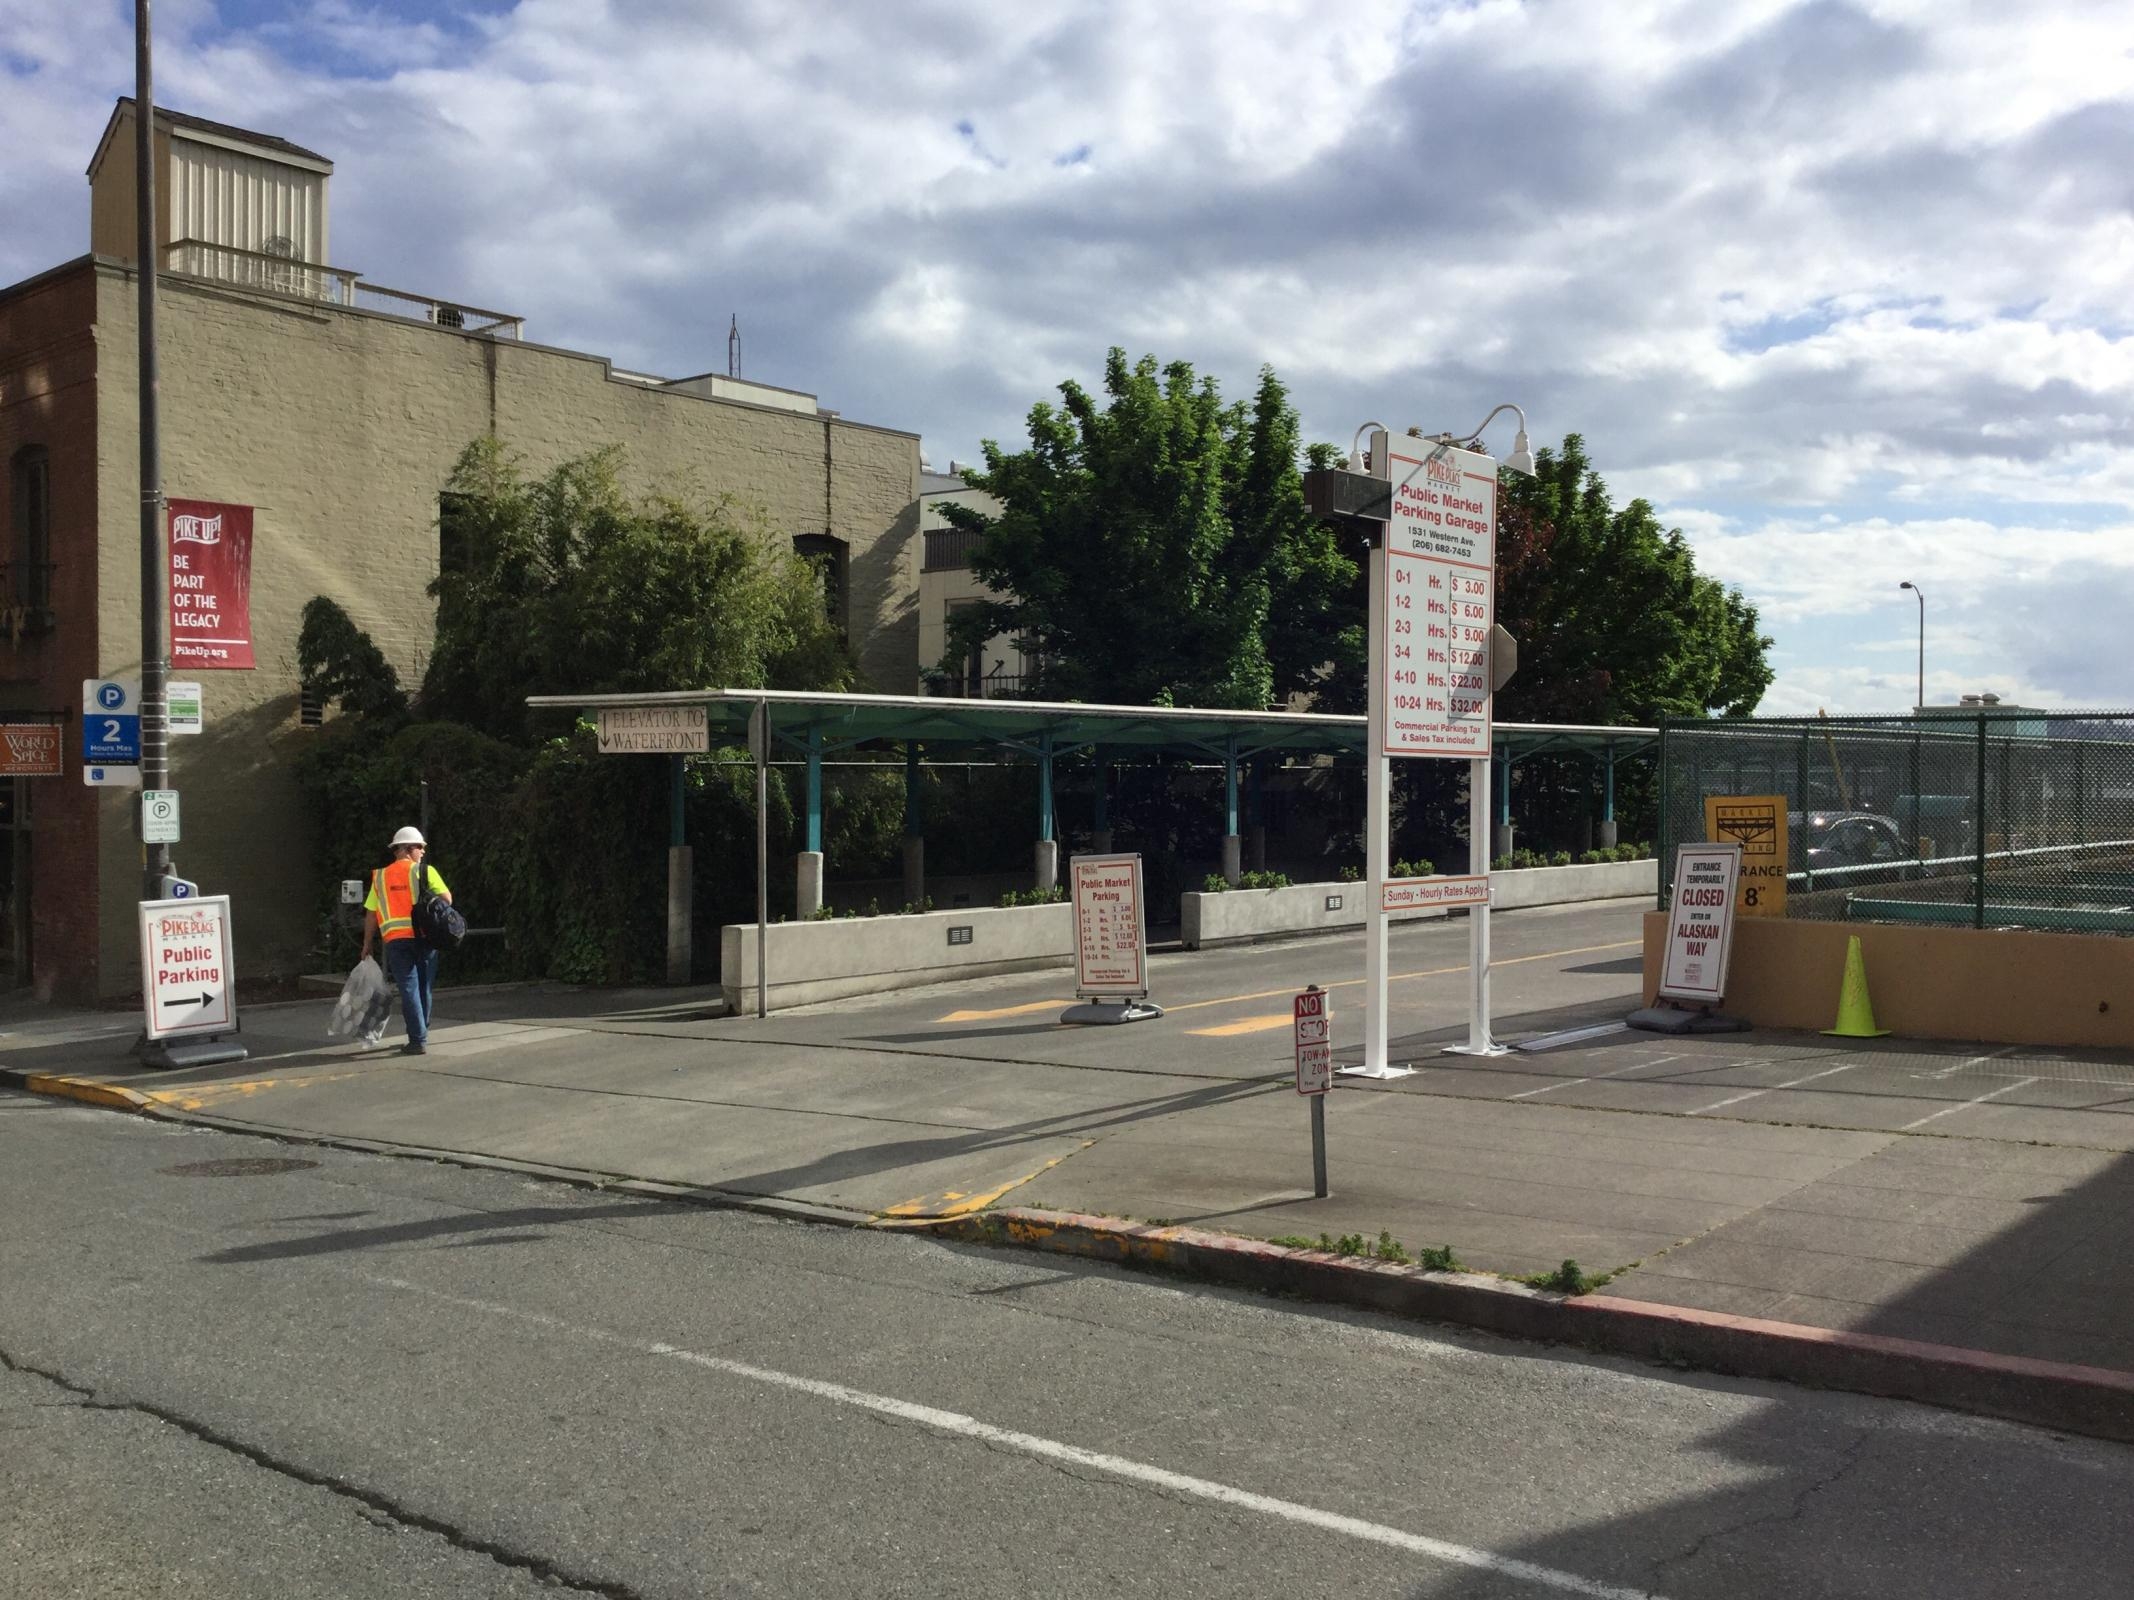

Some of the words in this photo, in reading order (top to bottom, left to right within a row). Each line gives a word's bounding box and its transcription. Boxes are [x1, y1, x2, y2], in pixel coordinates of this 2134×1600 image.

[1401, 484, 1438, 504] Public
[1442, 494, 1483, 514] Market
[1394, 501, 1441, 525] Parking
[1446, 513, 1488, 534] Garage
[174, 517, 199, 541] PIKE
[202, 515, 221, 541] UP!
[1408, 526, 1426, 537] 1531
[1429, 530, 1459, 542] Western
[1461, 537, 1476, 547] Ave.
[1412, 539, 1433, 552] (206)
[1435, 544, 1471, 557] 682-7453
[174, 555, 189, 569] BE
[174, 575, 204, 589] PART
[1396, 569, 1411, 584] 0-1
[1428, 575, 1442, 589] Hr.
[1465, 580, 1485, 595] 3.00
[174, 593, 191, 607] OF
[193, 594, 216, 609] THE
[1395, 594, 1411, 609] 1-2
[1427, 599, 1447, 614] Hrs.
[1464, 605, 1484, 619] 6.00
[175, 612, 220, 628] LEGACY
[1395, 619, 1411, 634] 2-3
[1427, 623, 1447, 639] Hrs.
[1464, 628, 1484, 643] 9.00
[175, 645, 228, 658] PikeUp.org
[1395, 644, 1410, 659] 3-4
[1427, 648, 1447, 663] Hrs.
[1394, 670, 1416, 684] 4-10
[1427, 673, 1446, 687] Hrs.
[1394, 695, 1421, 710] 10-24
[1426, 697, 1445, 712] Hrs.
[613, 710, 680, 728] ELEVATOR
[684, 709, 704, 727] TO
[103, 720, 120, 742] 2
[1395, 721, 1439, 731] Commercial
[1440, 723, 1467, 734] Parking
[1469, 725, 1481, 734] Tax
[4, 735, 55, 750] WORLD
[613, 731, 704, 749] WATERFRONT
[1401, 733, 1407, 742] &
[1410, 733, 1430, 743] Sales
[1432, 735, 1444, 743] Tax
[1446, 736, 1476, 745] included
[11, 749, 48, 764] SPICE
[1745, 844, 1772, 852] KING
[1692, 862, 1721, 871] ENTRANCE
[1741, 865, 1783, 877] RANCE
[1081, 879, 1103, 888] Public
[1105, 877, 1130, 887] Market
[1687, 874, 1725, 884] TEMPORARILY
[1092, 891, 1120, 902] Parking
[1388, 889, 1415, 902] Sunday
[1420, 887, 1443, 900] Hourly
[1444, 885, 1463, 897] Rates
[1465, 884, 1484, 896] Apply
[1682, 888, 1724, 906] CLOSED
[161, 919, 189, 936] PIKE
[190, 920, 214, 933] PLACE
[1677, 923, 1719, 939] ALASKAN
[163, 945, 212, 963] Public
[1686, 941, 1707, 956] WAY
[159, 966, 219, 985] Parking
[1299, 996, 1318, 1015] NO
